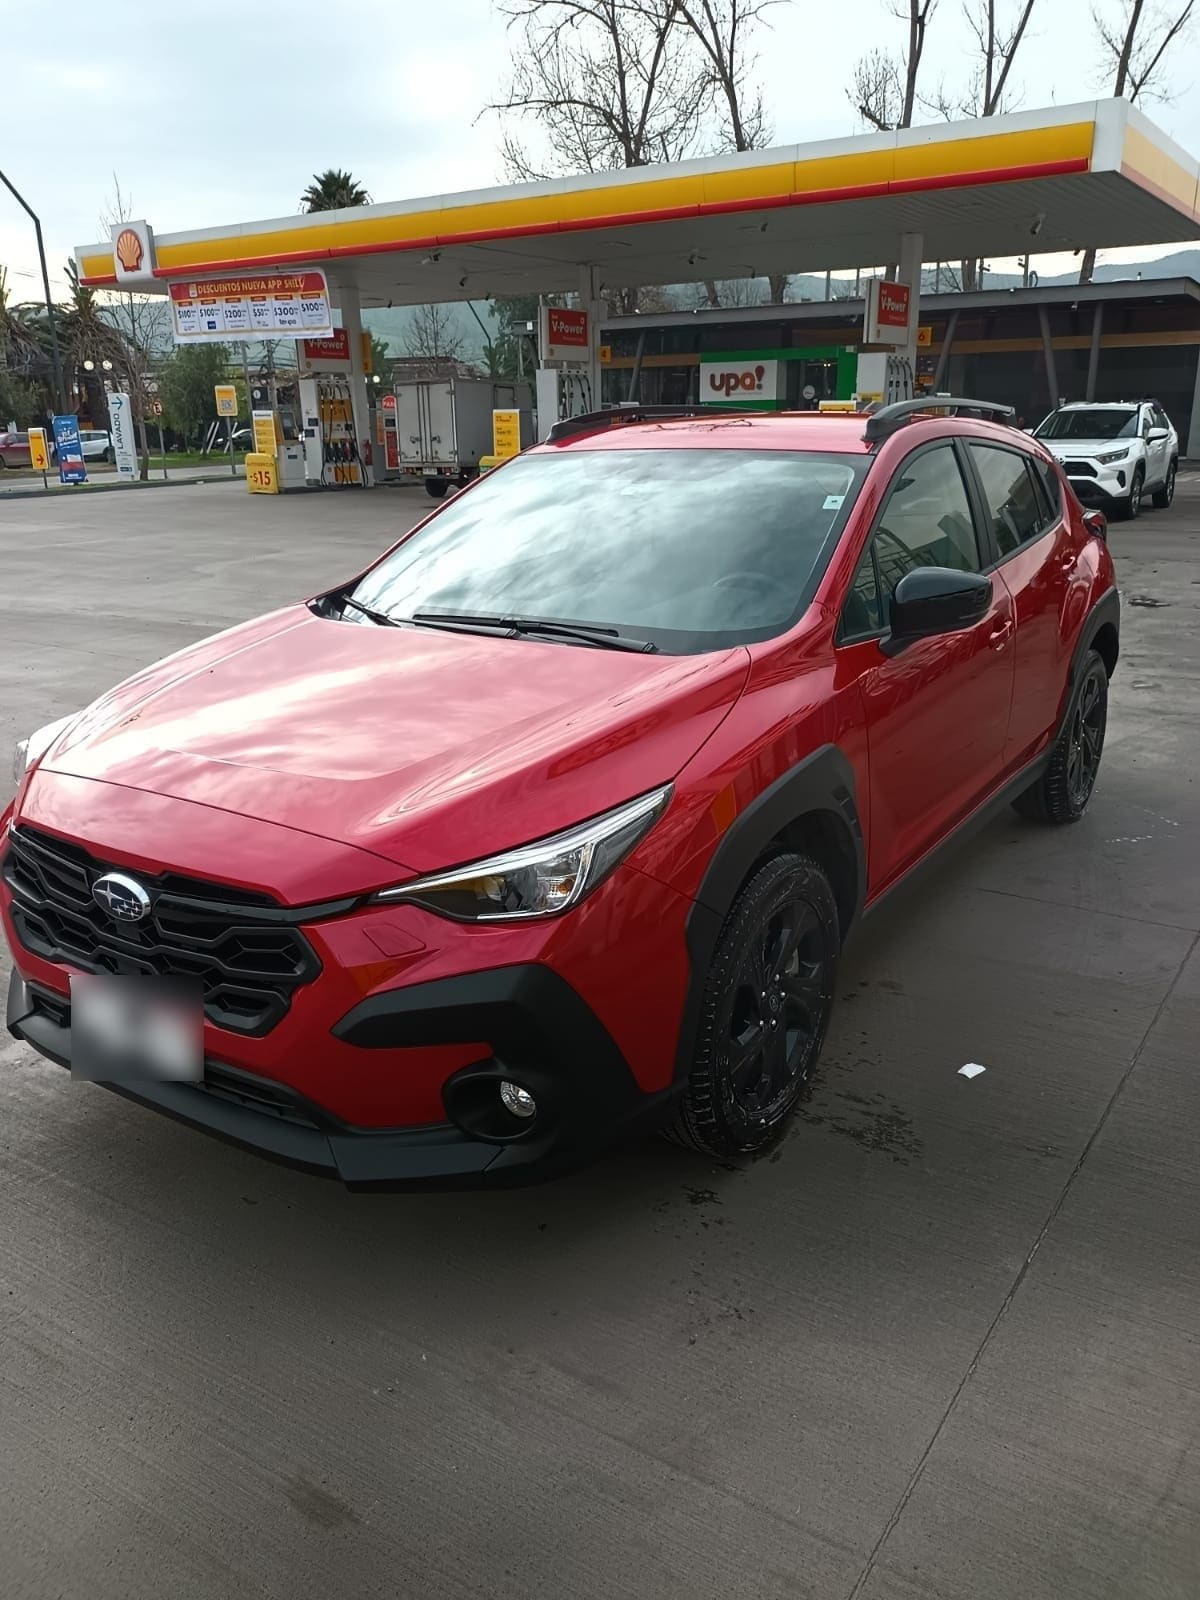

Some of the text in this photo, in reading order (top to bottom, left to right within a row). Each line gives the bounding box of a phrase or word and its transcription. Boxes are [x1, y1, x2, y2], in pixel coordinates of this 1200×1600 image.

[198, 281, 240, 294] DESCUENTOS
[241, 280, 266, 291] NUEVA
[267, 279, 282, 289] APP
[301, 302, 319, 312] $100
[881, 295, 906, 313] V-Power
[551, 320, 584, 335] V-Power
[709, 365, 765, 397] upa!
[113, 413, 124, 450] LAVADO
